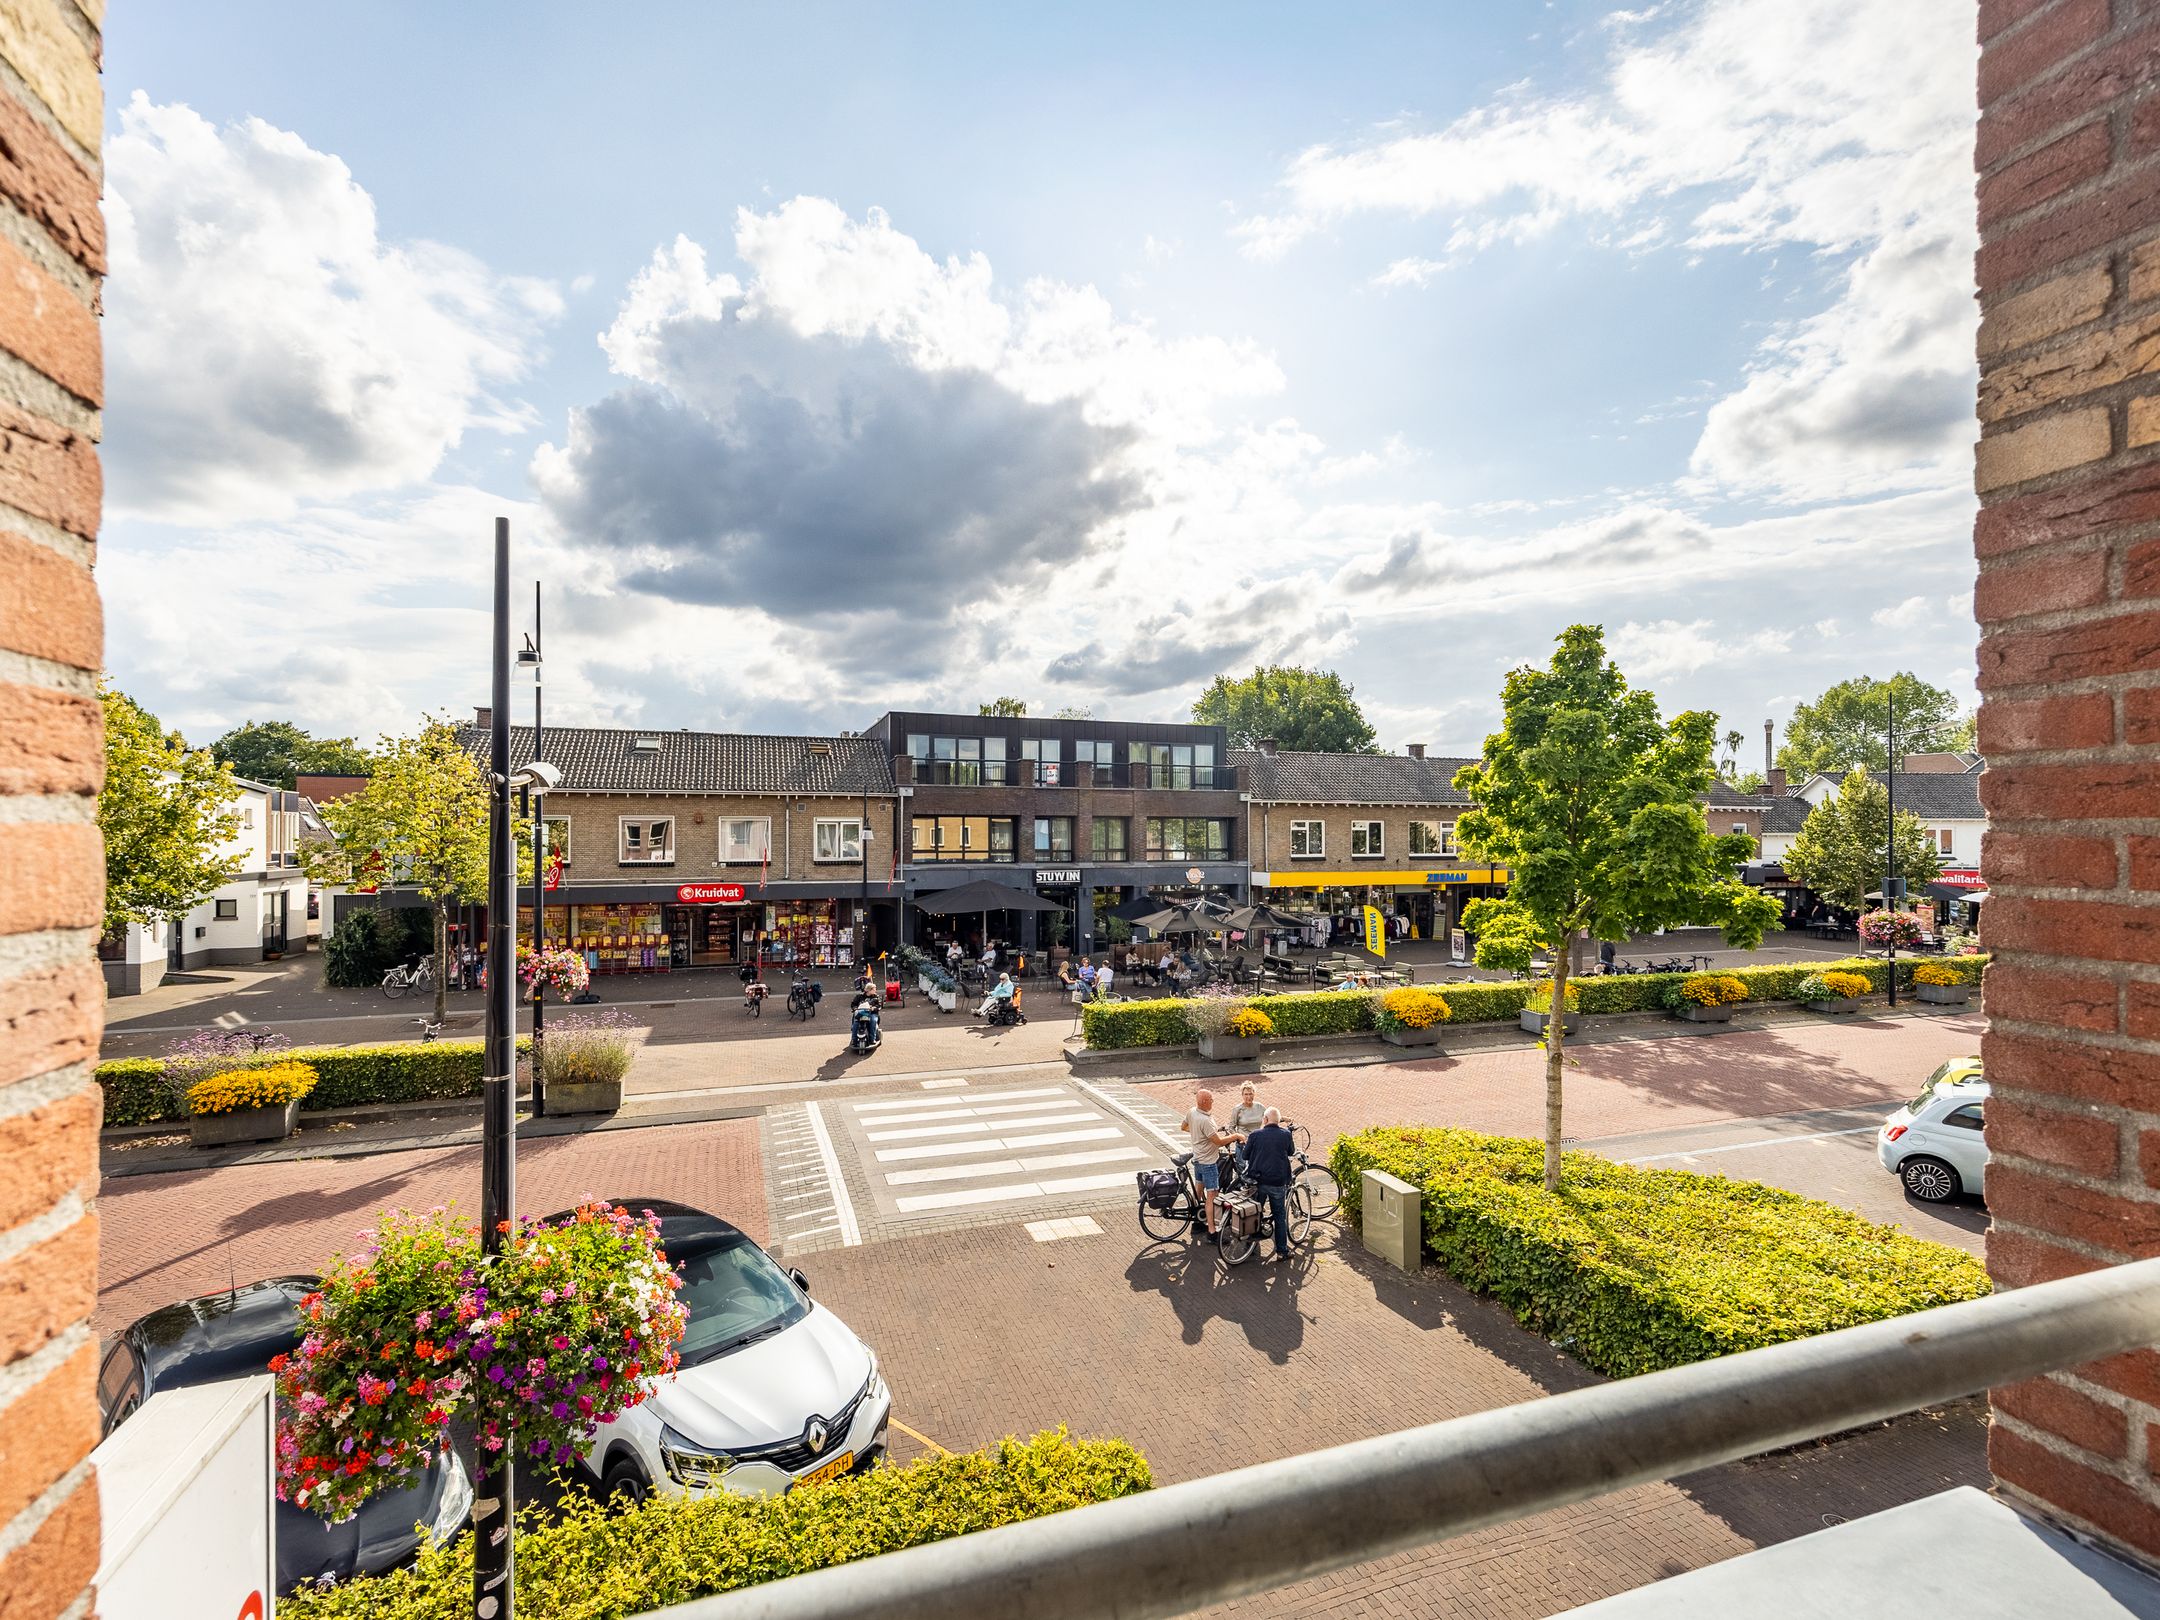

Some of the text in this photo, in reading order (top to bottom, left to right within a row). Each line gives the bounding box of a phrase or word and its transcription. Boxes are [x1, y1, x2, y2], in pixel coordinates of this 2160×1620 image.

[1036, 872, 1080, 881] STUYV INN
[1426, 873, 1468, 882] ZEEMAN
[694, 887, 739, 898] Kruidvat
[1370, 912, 1378, 950] ZEEMAN
